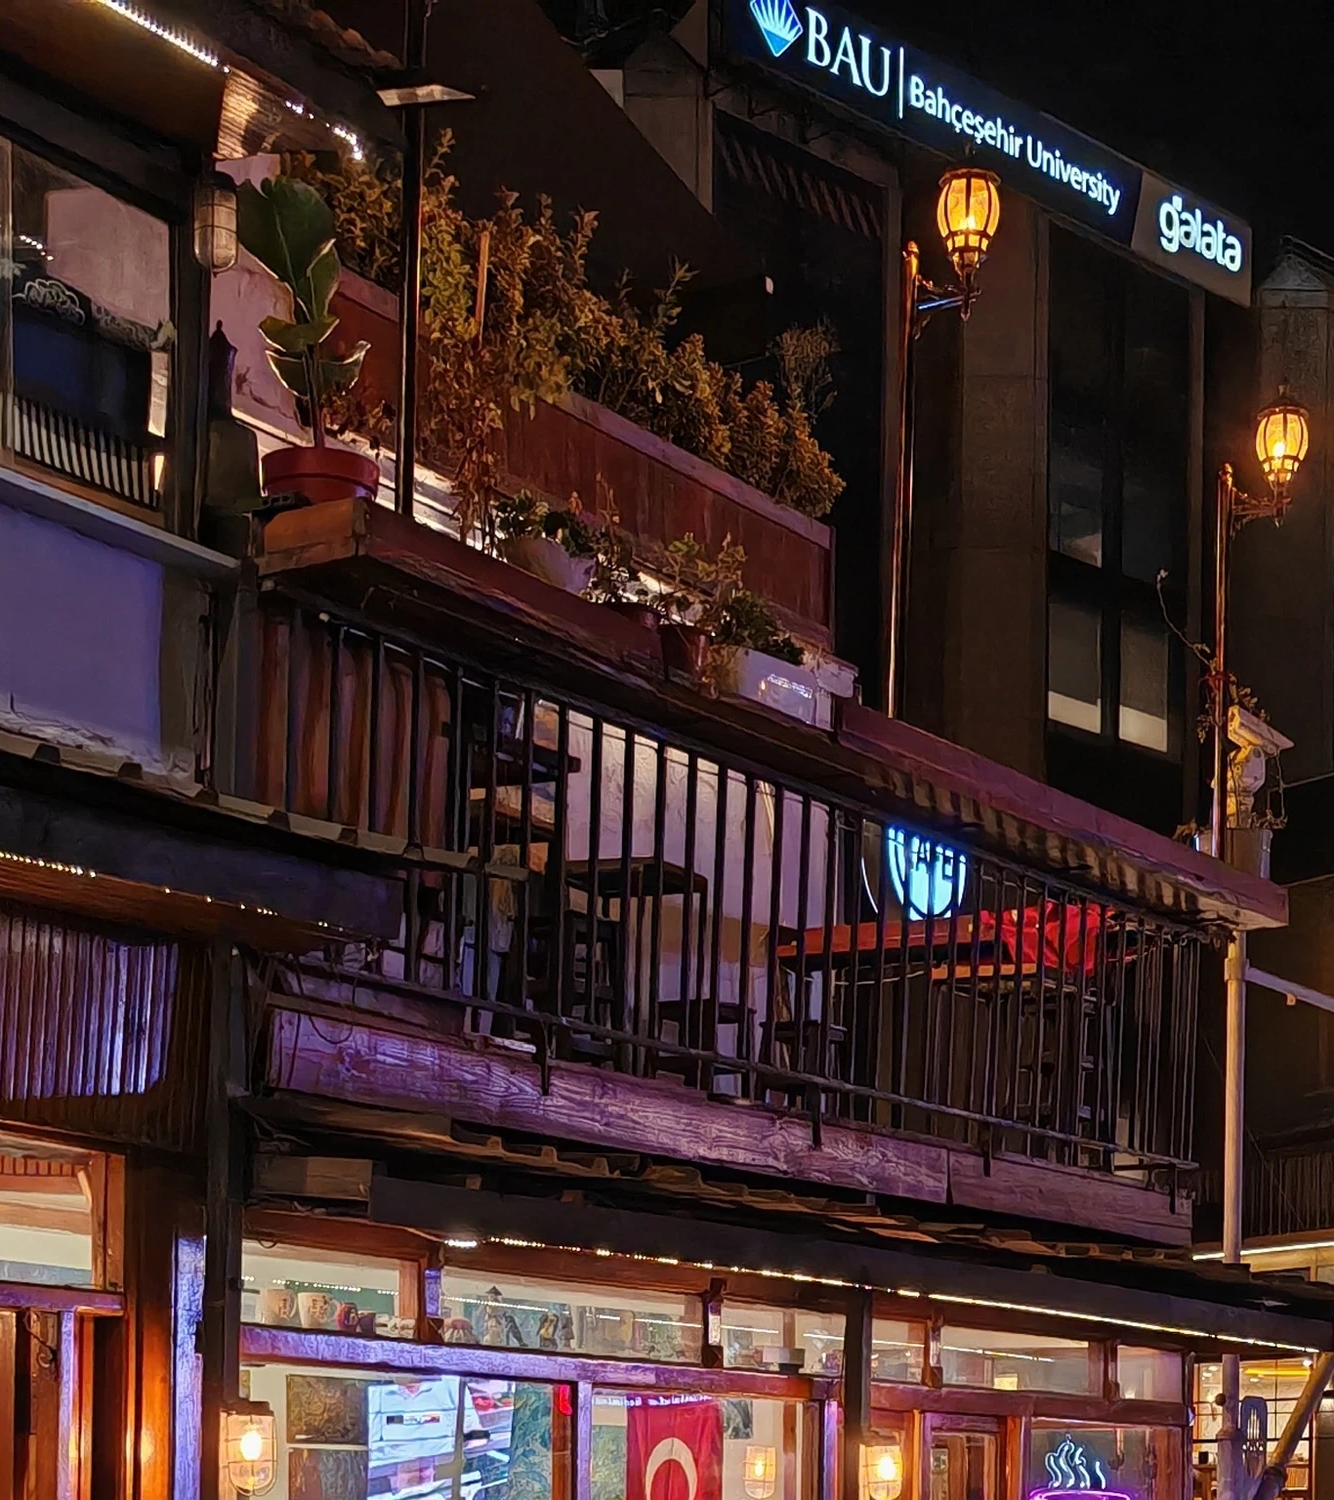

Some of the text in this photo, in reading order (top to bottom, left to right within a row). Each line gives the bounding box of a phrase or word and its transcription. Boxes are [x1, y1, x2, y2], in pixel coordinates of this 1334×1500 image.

[805, 6, 892, 97] BAU
[910, 74, 1121, 216] Bahçeşehir University
[1159, 194, 1243, 273] galata
